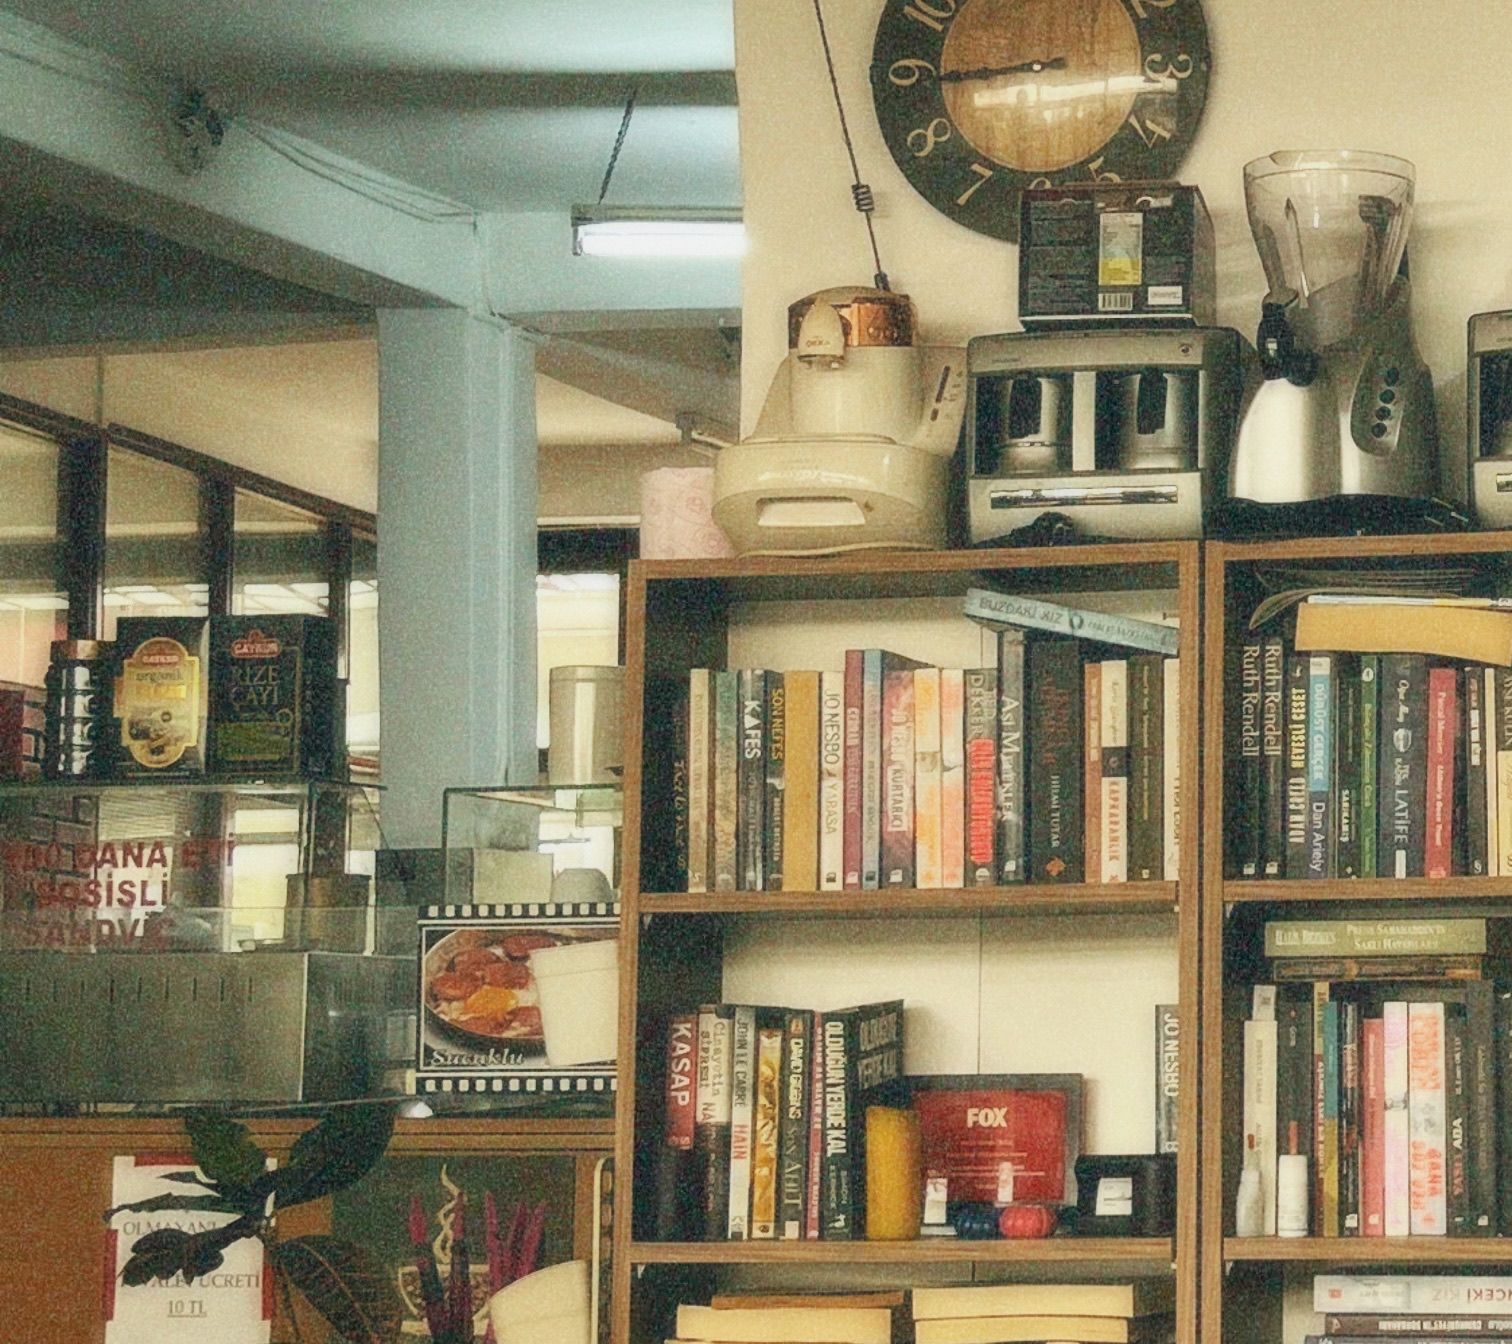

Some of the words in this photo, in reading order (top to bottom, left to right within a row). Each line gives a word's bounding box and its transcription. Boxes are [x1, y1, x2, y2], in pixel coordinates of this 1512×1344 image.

[888, 58, 938, 87] 9
[1144, 53, 1194, 81] 3
[906, 117, 951, 158] 8
[957, 162, 993, 206] 7
[1243, 645, 1259, 686] Ruth
[1264, 645, 1281, 685] Ruth
[824, 690, 840, 709] JO
[1289, 689, 1305, 720] CESET
[744, 699, 762, 759] KAFES
[1243, 692, 1259, 756] Rendell
[1264, 692, 1281, 755] Rendell
[825, 782, 838, 834] YARASA
[1311, 802, 1324, 828] Dan
[1394, 789, 1411, 844] LATİFE
[1309, 834, 1325, 872] Ariely
[36, 872, 168, 907] SOSİSLİ
[736, 1018, 748, 1050] JOHN
[825, 1021, 847, 1083] OLDUĞUN
[670, 1022, 692, 1107] KASAP
[825, 1085, 845, 1128] YERDE
[966, 1106, 1008, 1129] FOX
[826, 1129, 846, 1157] KAL
[168, 1299, 187, 1316] 10
[188, 1299, 207, 1316] TL
